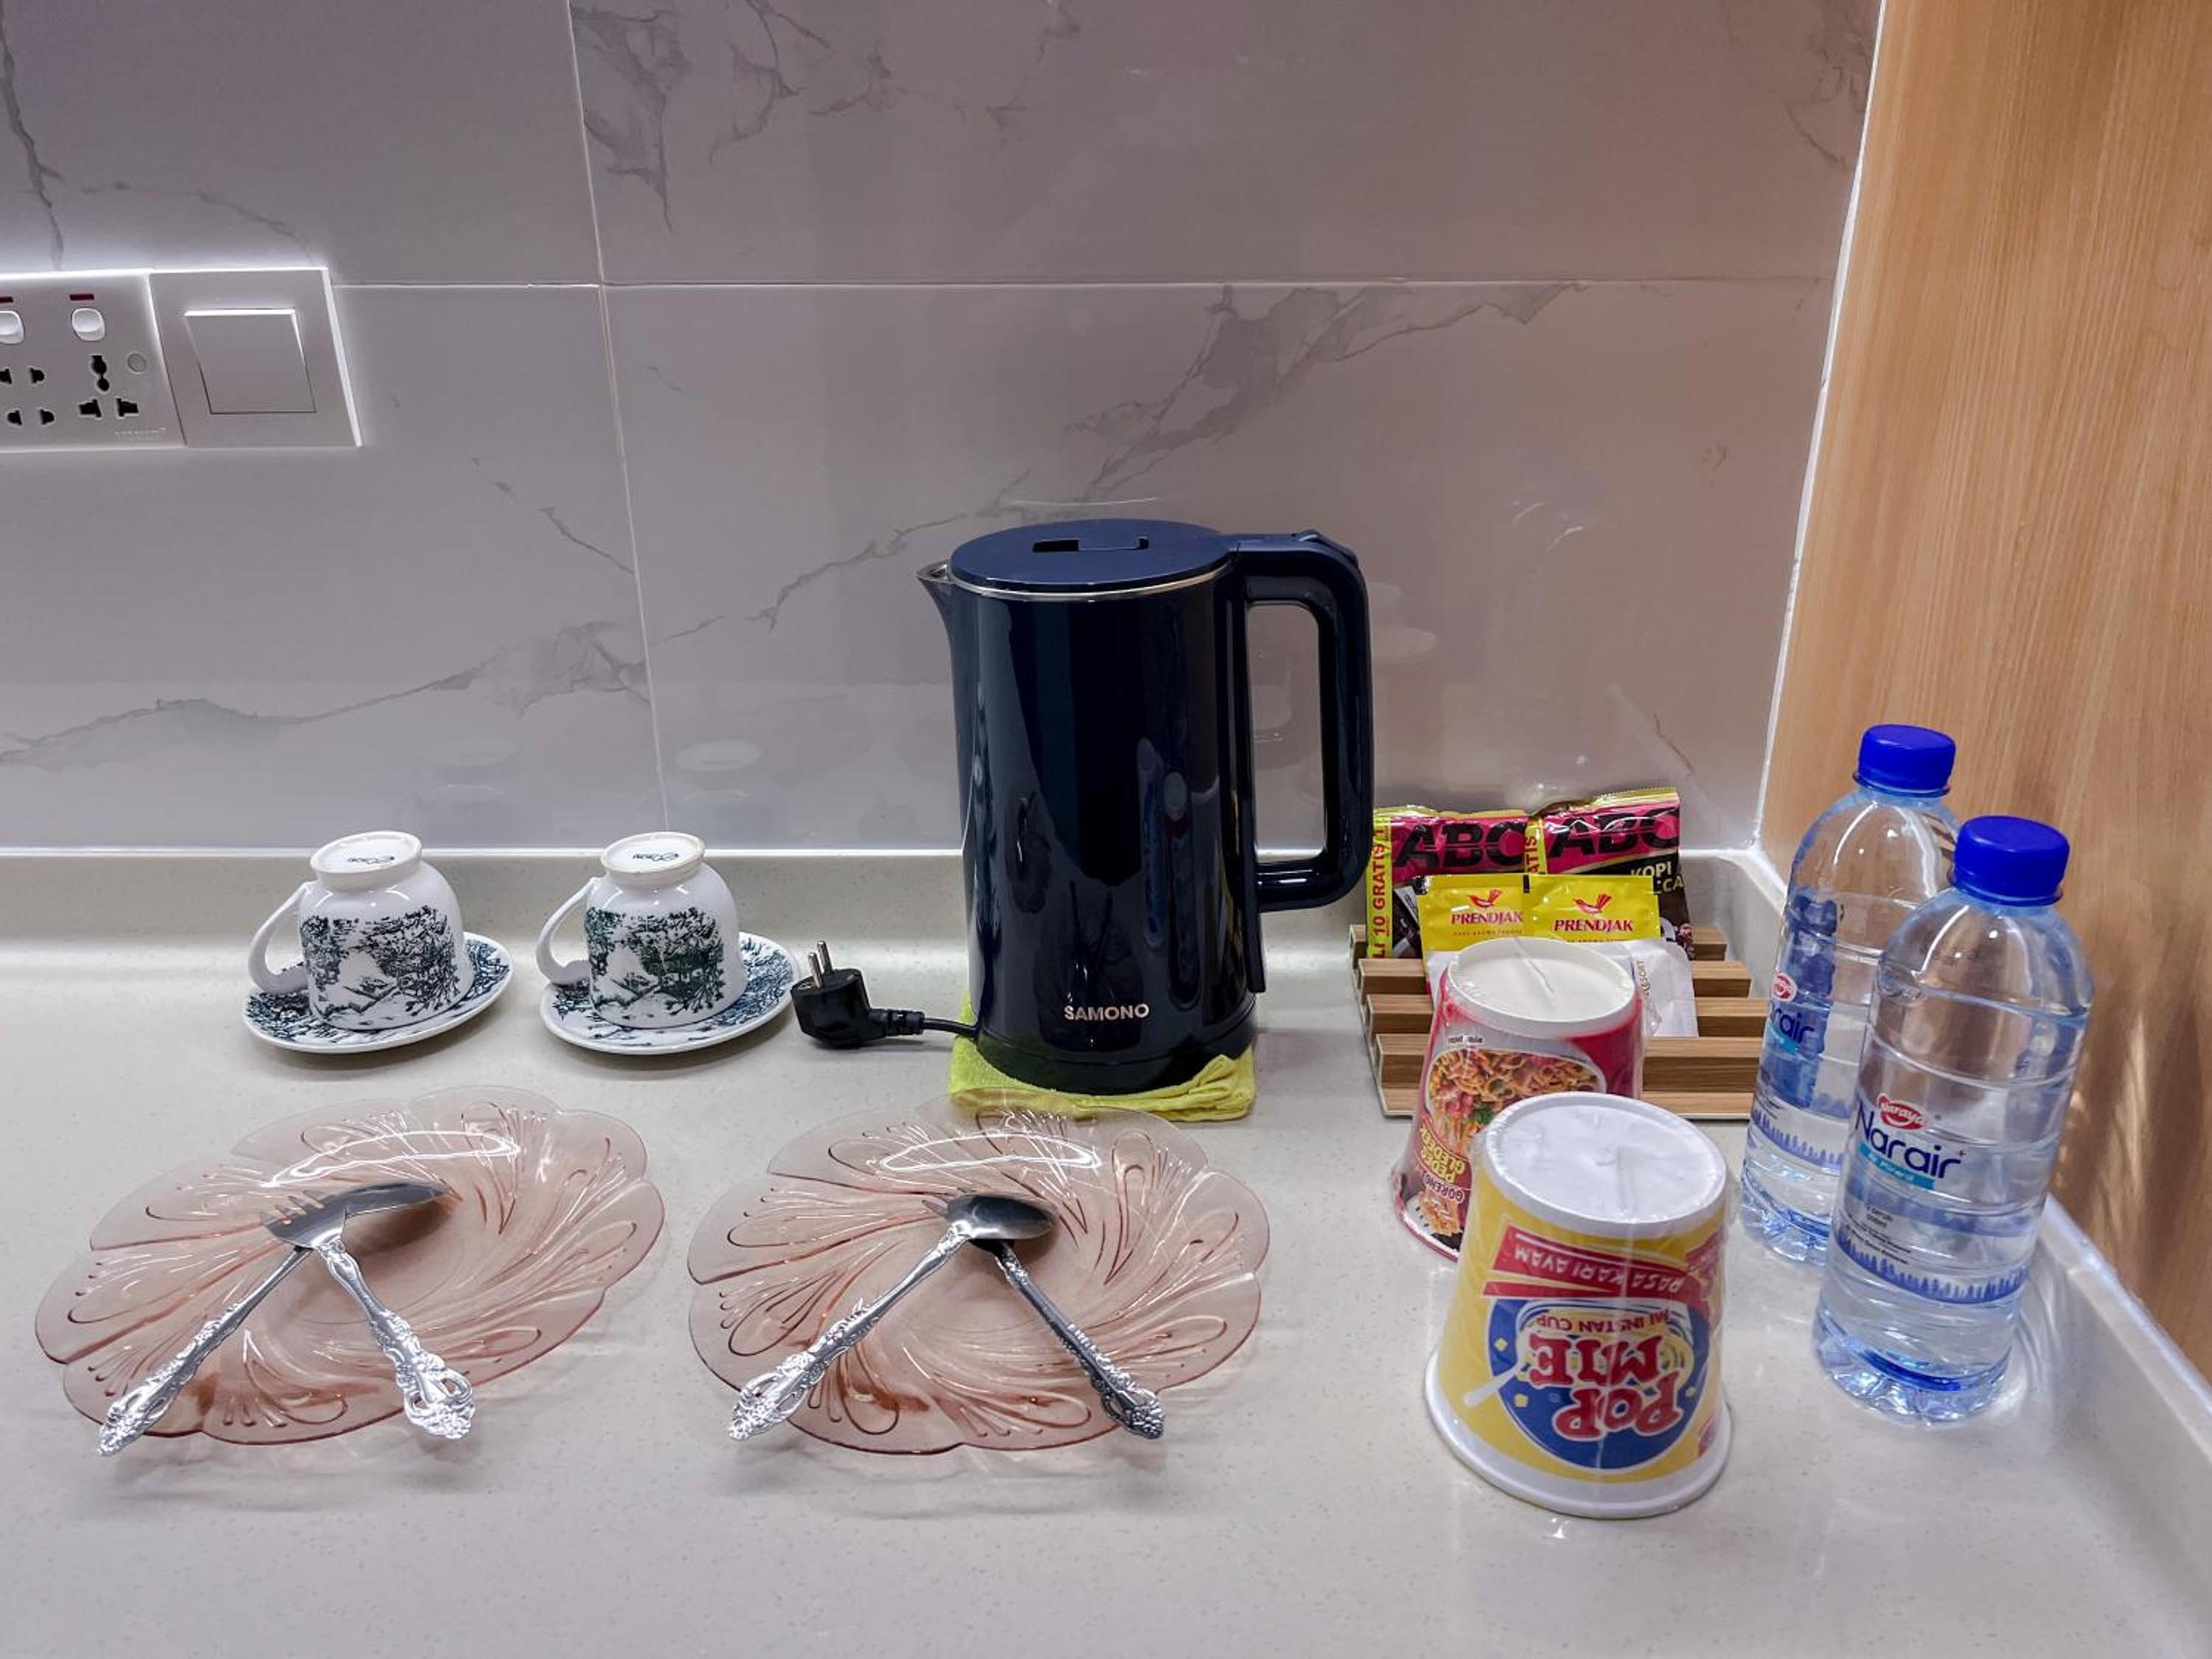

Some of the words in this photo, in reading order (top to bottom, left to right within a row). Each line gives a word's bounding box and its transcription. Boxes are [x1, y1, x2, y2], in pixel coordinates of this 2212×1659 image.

[1394, 821, 1526, 868] ABC
[1548, 807, 1680, 858] ABC
[1373, 845, 1385, 910] GRATIS
[1374, 916, 1385, 935] 10
[1451, 911, 1523, 925] PRENDJAK
[1554, 919, 1634, 933] PRENDJAK
[1064, 1004, 1150, 1021] SAMONO
[1855, 1099, 1961, 1179] Narair
[1515, 1246, 1568, 1274] AYAM
[1572, 1265, 1625, 1287] KARI
[1630, 1271, 1685, 1294] RASA
[1536, 1314, 1573, 1332] CUP
[1528, 1333, 1663, 1388] MIE
[1554, 1371, 1683, 1440] POP
